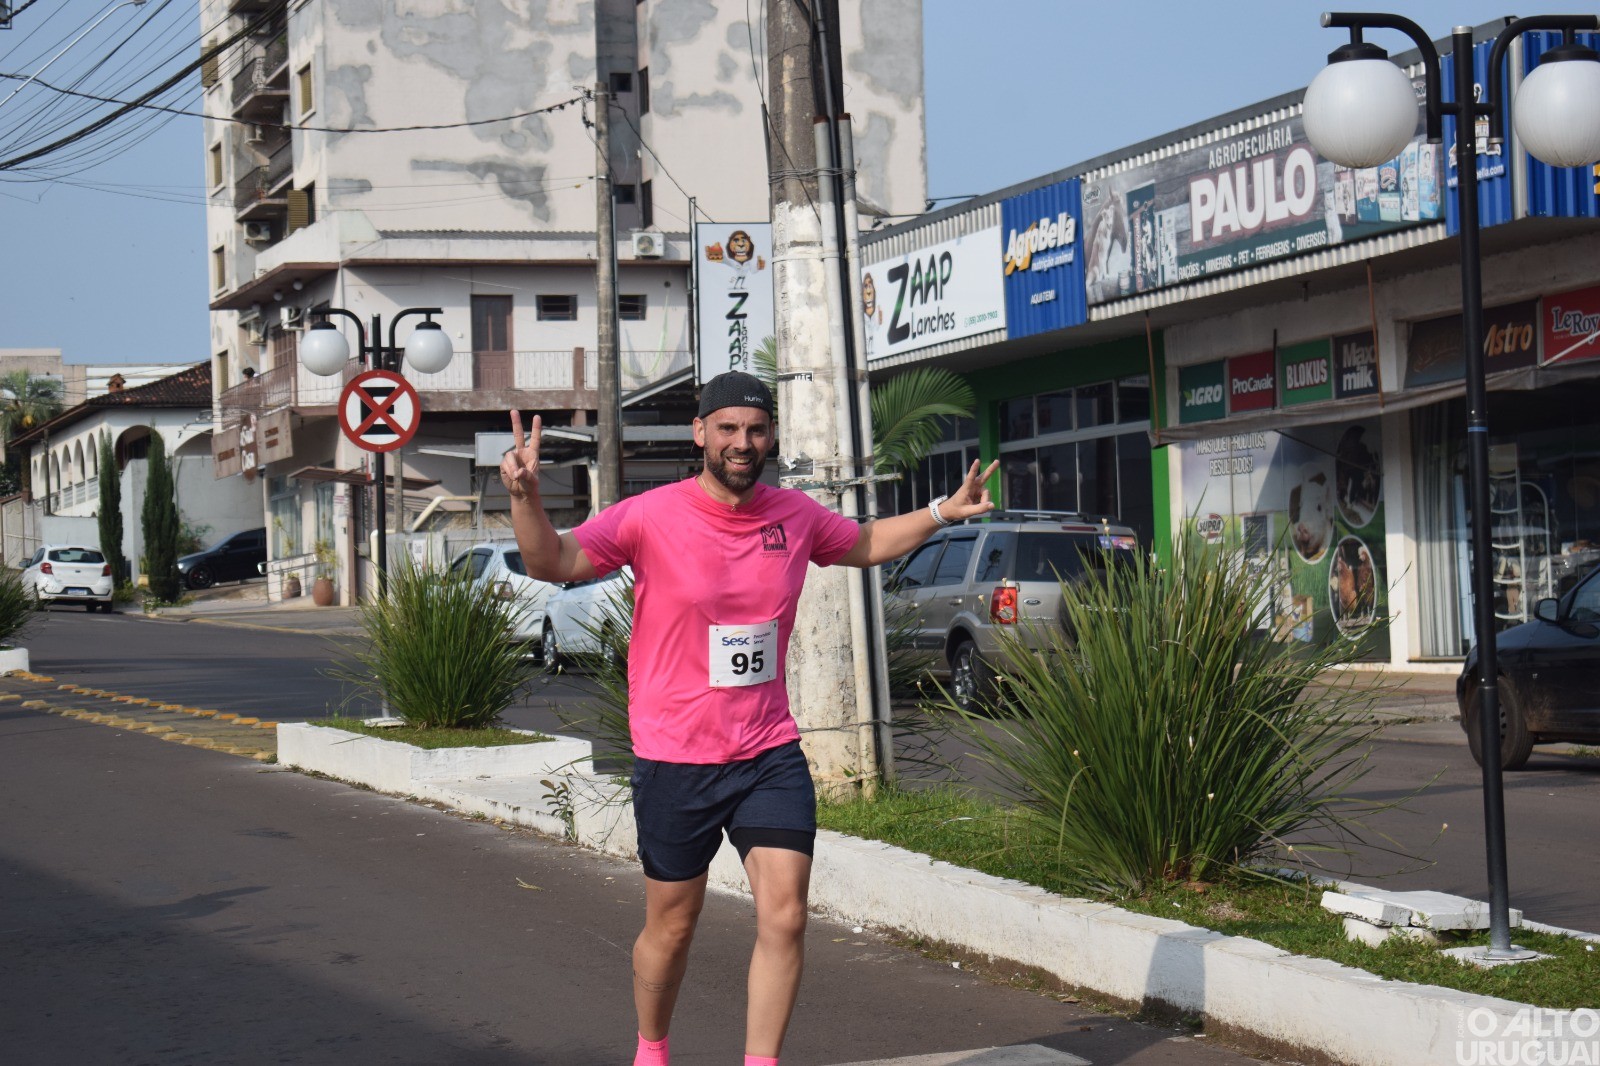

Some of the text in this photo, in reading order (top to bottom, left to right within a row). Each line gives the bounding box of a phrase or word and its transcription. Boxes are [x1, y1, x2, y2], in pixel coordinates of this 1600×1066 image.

[1208, 125, 1293, 170] AGROPECUÁRIA
[1190, 148, 1316, 243] PAULO
[1005, 212, 1076, 267] AgroBella
[1178, 231, 1326, 280] RAÇÕES MINERAIS PET FERRAGENS DIVERSOS
[887, 251, 952, 345] ZAAP
[725, 292, 749, 371] ZAAP
[911, 306, 956, 340] Lanches
[1286, 358, 1328, 389] BLOKUS
[1343, 365, 1373, 391] milk
[744, 395, 764, 403] Hurley
[1209, 456, 1253, 477] RESULTADOS!
[1199, 520, 1222, 532] SUPRA
[731, 650, 764, 676] 95
